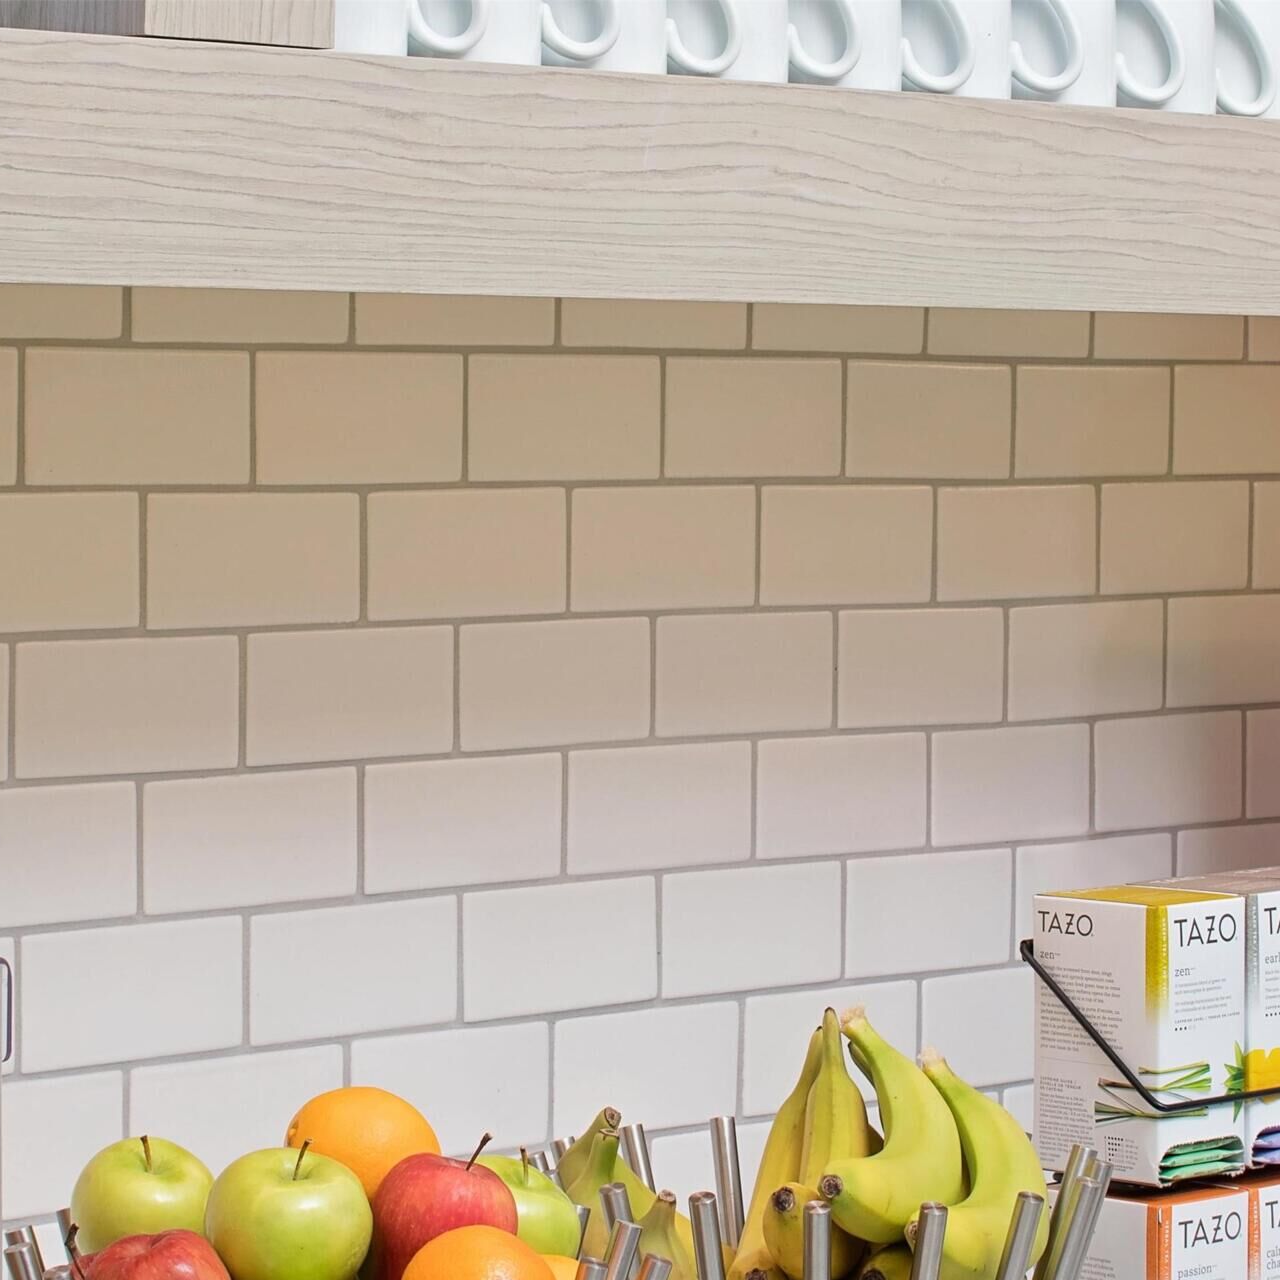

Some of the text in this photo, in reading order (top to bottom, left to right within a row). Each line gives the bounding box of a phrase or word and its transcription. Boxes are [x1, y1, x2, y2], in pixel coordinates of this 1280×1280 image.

[1037, 910, 1093, 936] TAZO
[1173, 913, 1237, 947] TAZO
[1264, 951, 1280, 965] earl
[1178, 1211, 1241, 1248] TAZO
